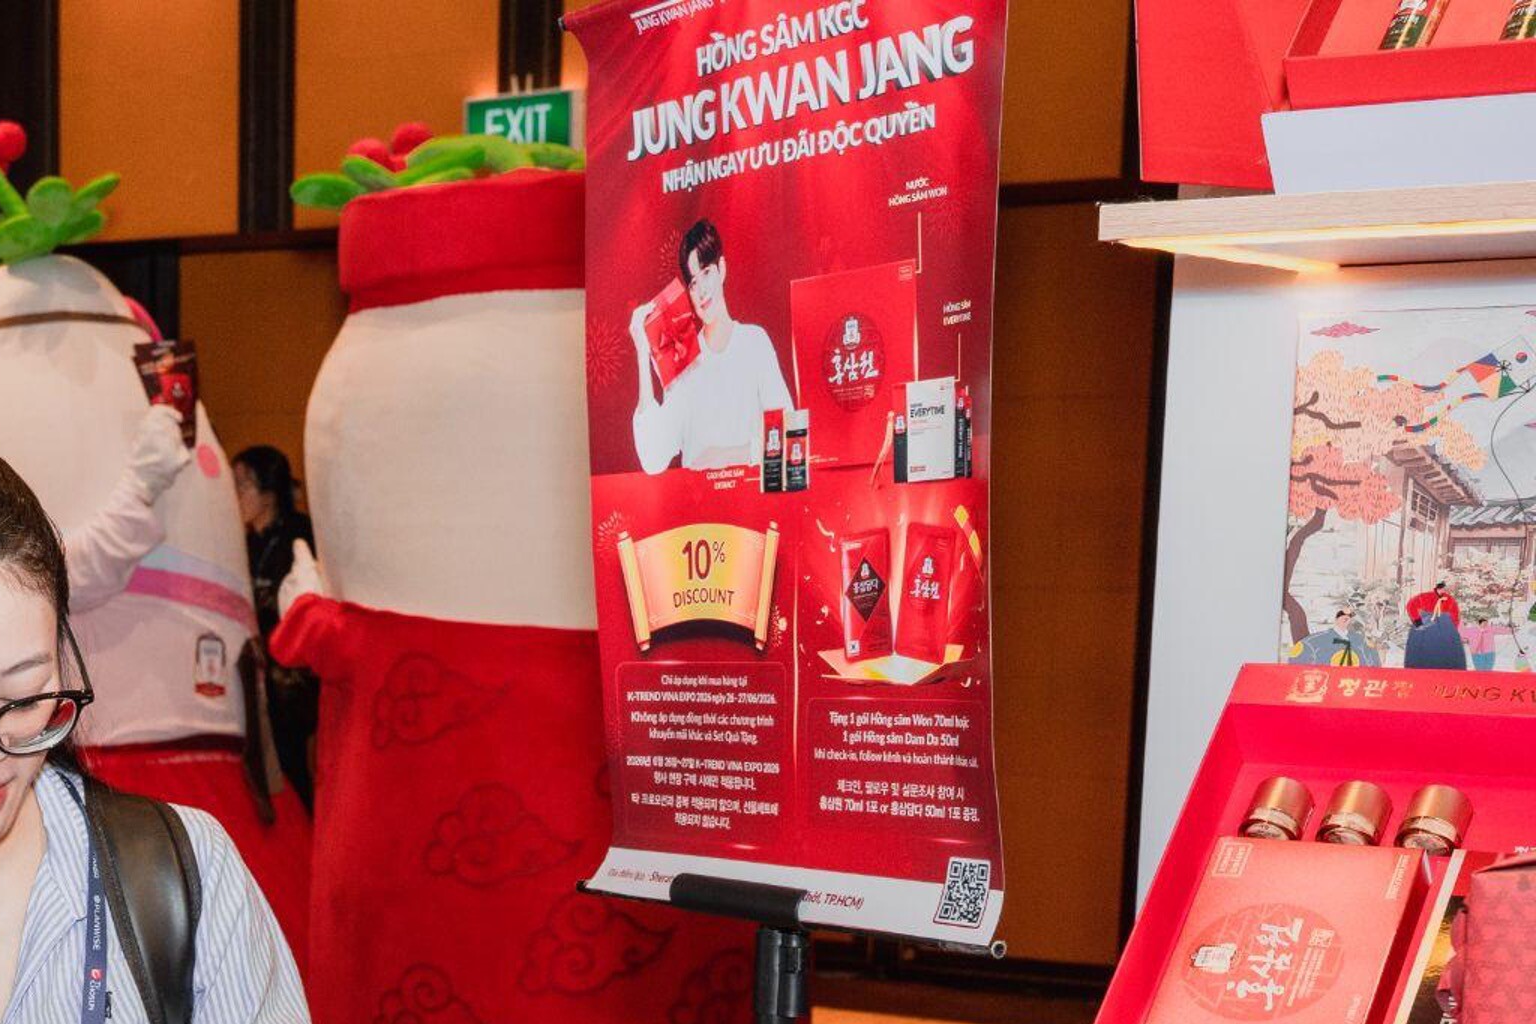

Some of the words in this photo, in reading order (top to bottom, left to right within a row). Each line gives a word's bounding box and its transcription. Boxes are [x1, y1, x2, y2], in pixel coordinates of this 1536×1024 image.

[634, 13, 660, 35] JUNG
[658, 6, 690, 26] KWAN
[696, 29, 757, 77] HỒNG
[760, 12, 816, 55] SÂM
[817, 0, 869, 40] KGC
[627, 89, 716, 161] JUNG
[721, 49, 851, 134] KWAN
[859, 15, 975, 101] JANG
[484, 103, 552, 144] EXIT
[662, 158, 705, 194] NHẬN
[705, 149, 747, 182] NGAY
[749, 139, 781, 168] ƯU
[782, 129, 816, 163] ĐÃI
[818, 120, 863, 161] ĐỘC
[865, 101, 936, 143] QUYỀN
[910, 404, 945, 419] EVERYTIME
[681, 539, 726, 580] 10%
[672, 587, 735, 608] DISCOUNT
[912, 714, 932, 726] Won
[934, 714, 954, 728] 70ml
[905, 732, 924, 745] Dam
[927, 733, 939, 746] Da
[940, 733, 959, 747] 50ml
[744, 761, 762, 773] EXPO
[844, 798, 863, 811] 70ml
[880, 803, 889, 813] or
[925, 804, 945, 818] 50ml
[92, 904, 101, 951] PLANWISE
